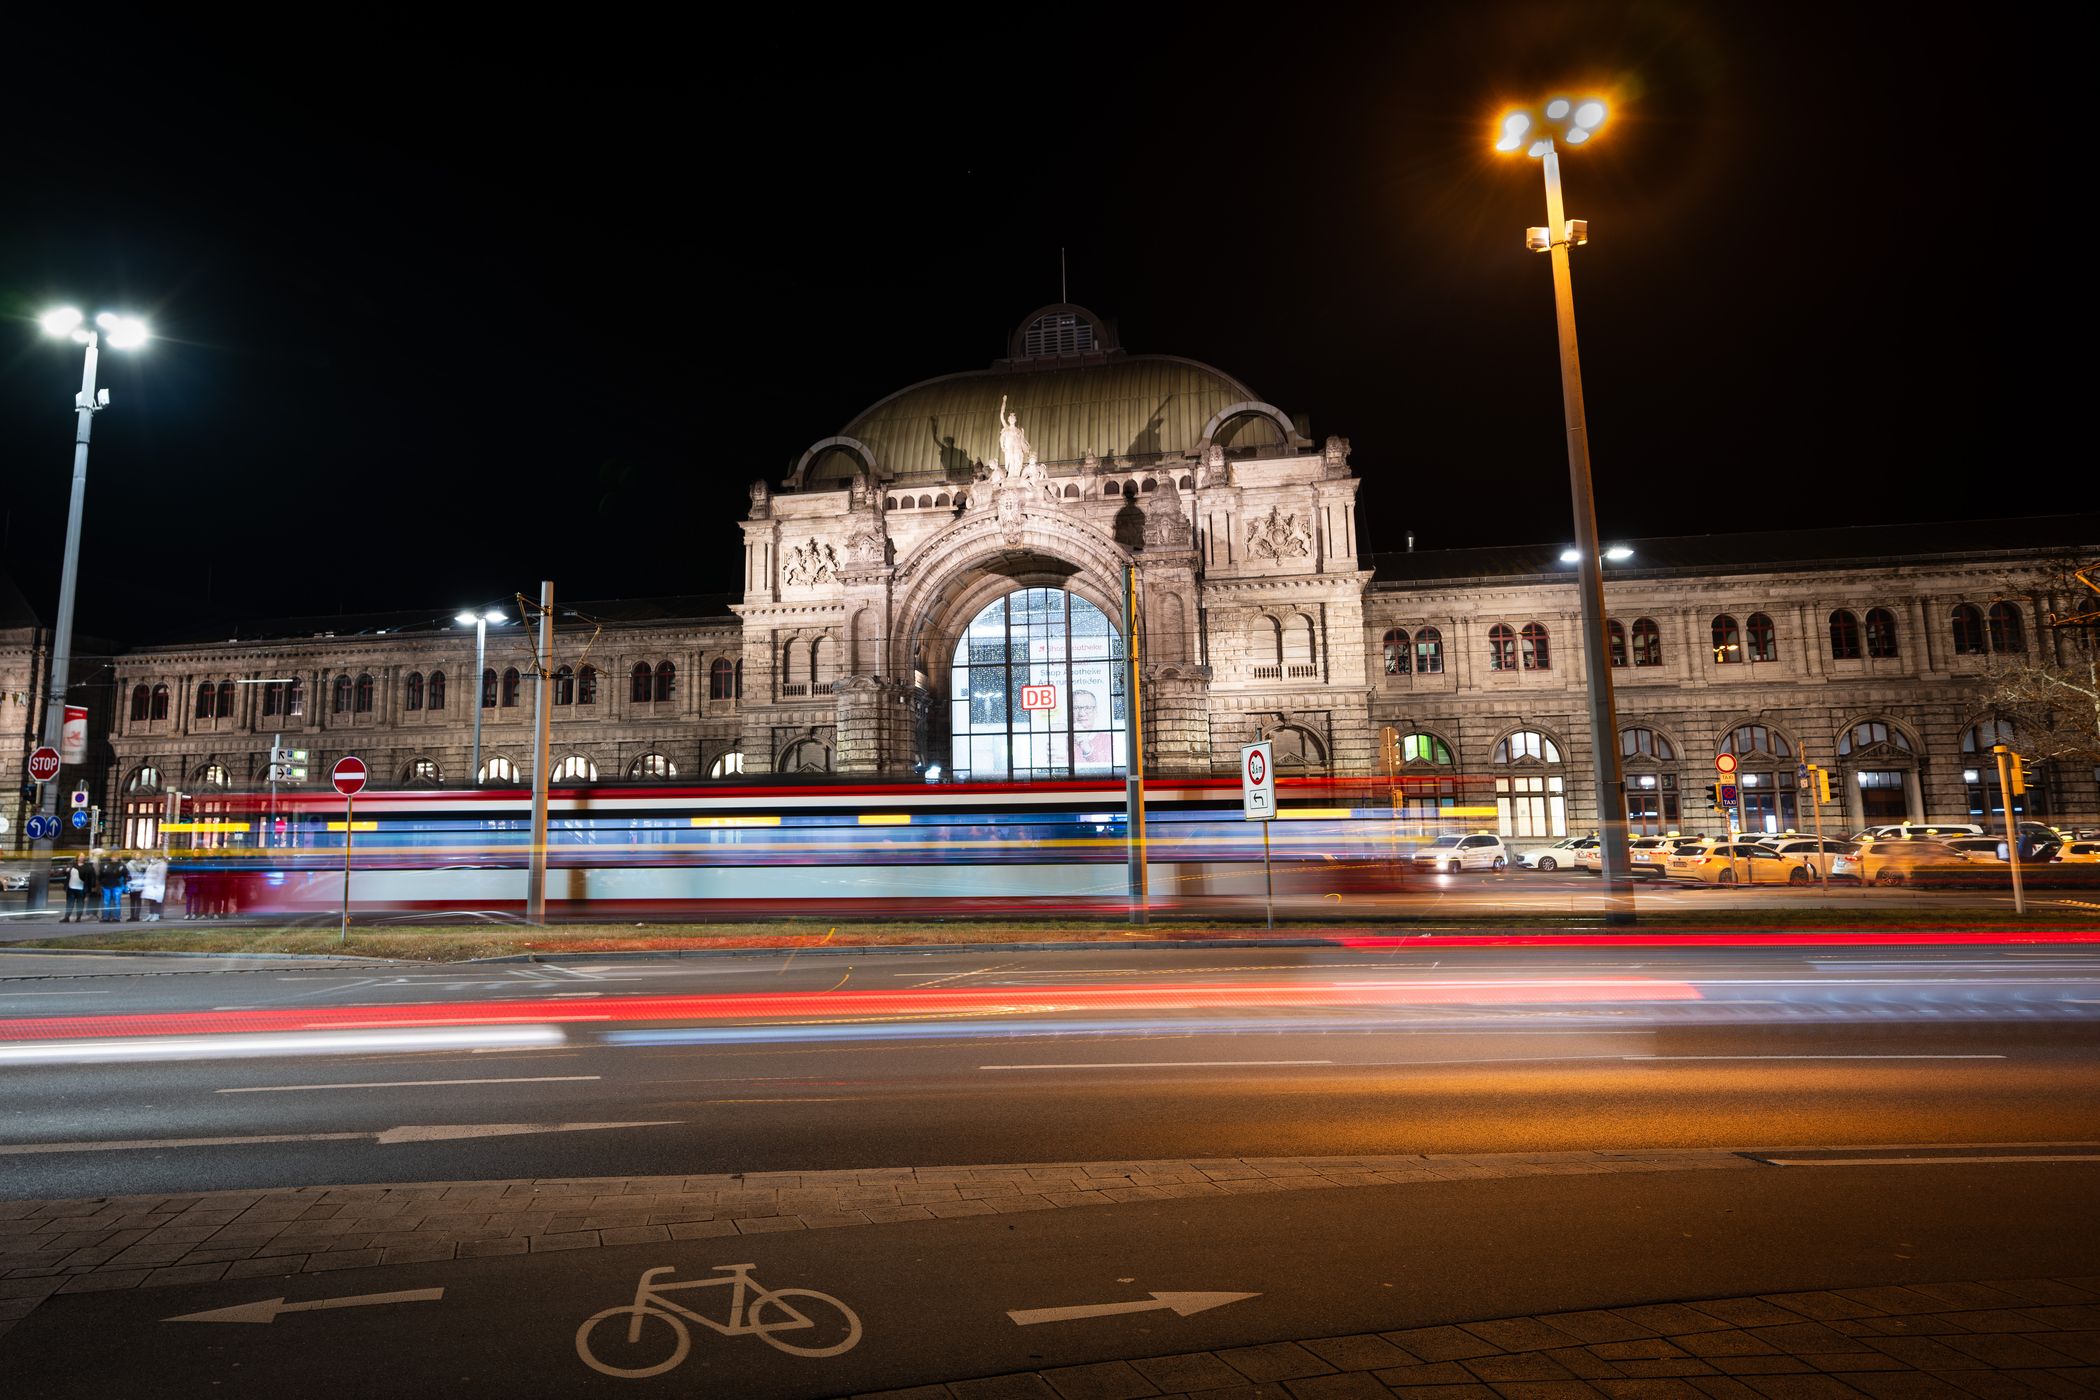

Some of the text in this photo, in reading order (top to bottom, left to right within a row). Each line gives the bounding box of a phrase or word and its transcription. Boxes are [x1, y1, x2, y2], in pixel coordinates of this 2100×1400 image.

[1064, 668, 1101, 676] otheke
[1027, 690, 1052, 706] DB
[32, 757, 57, 771] STOP
